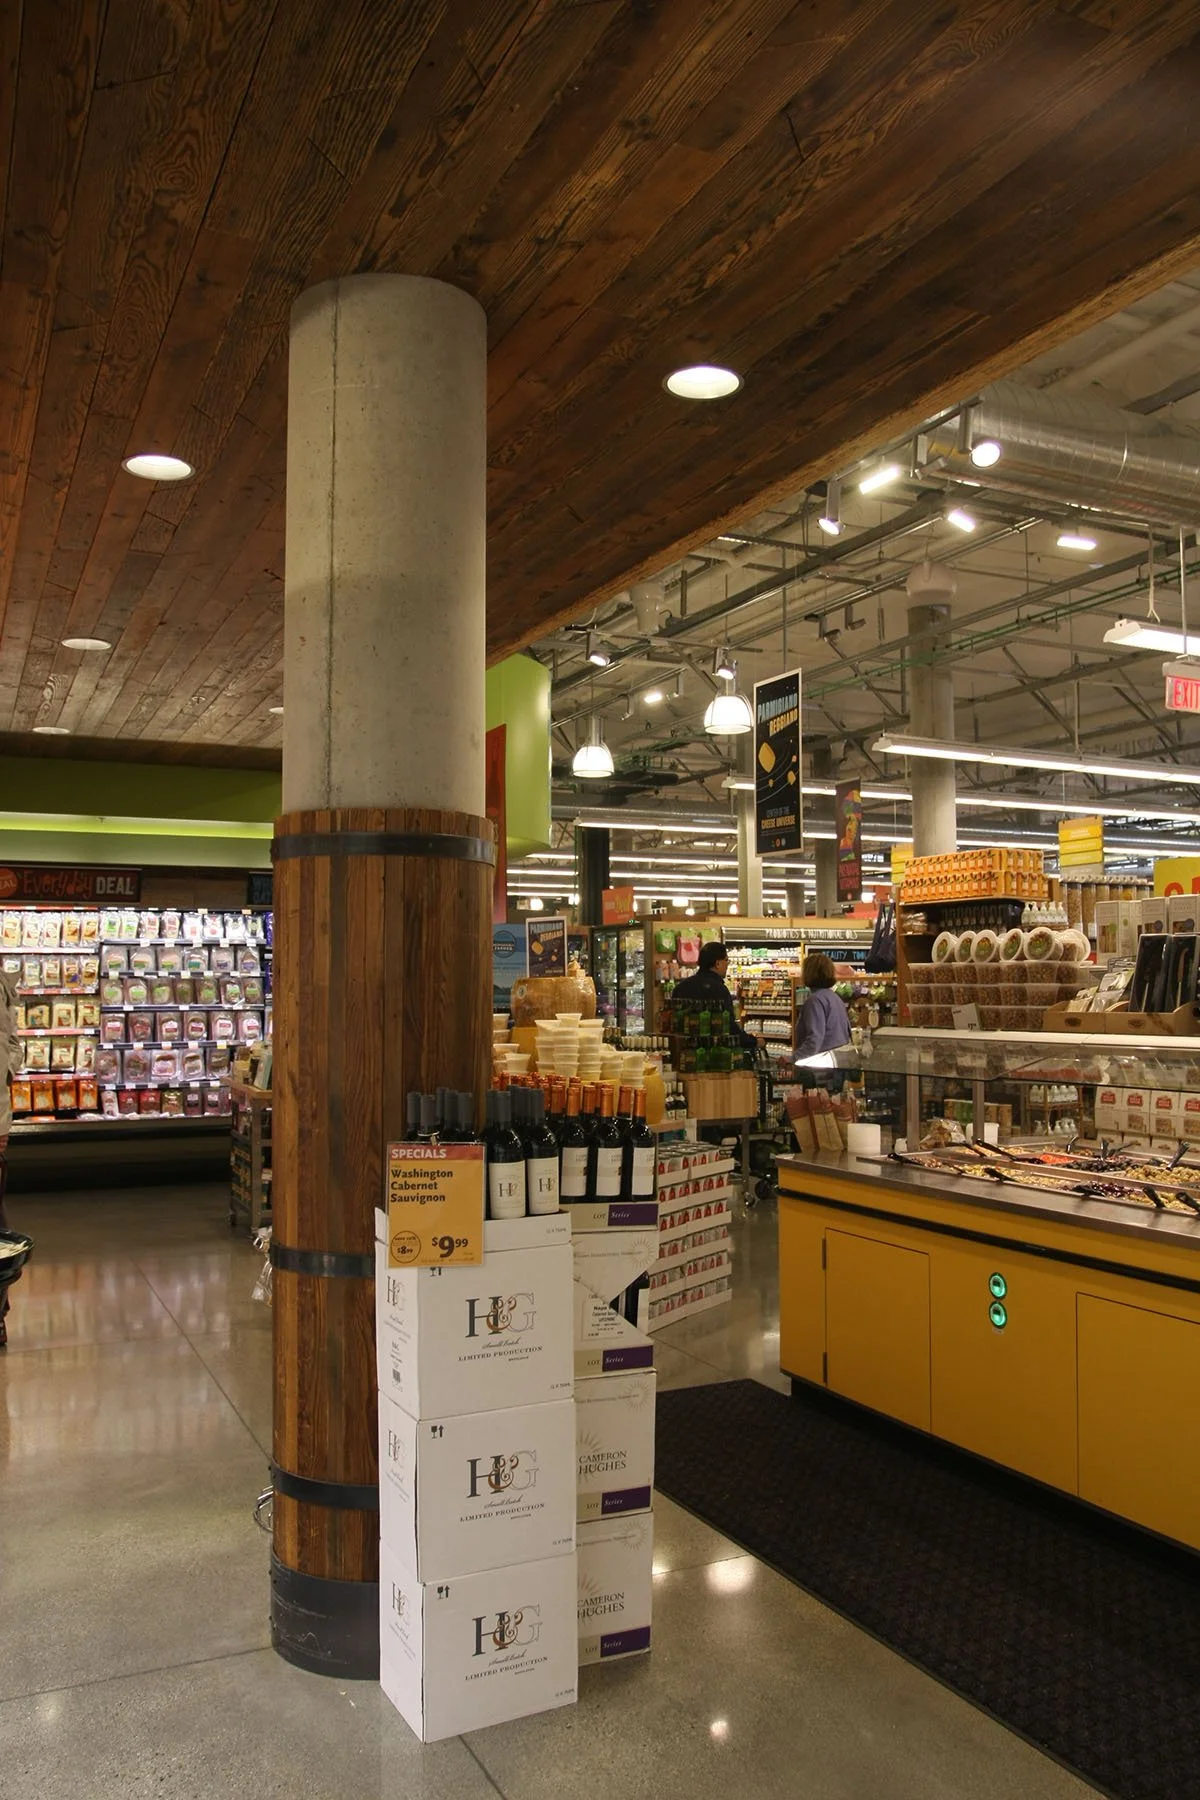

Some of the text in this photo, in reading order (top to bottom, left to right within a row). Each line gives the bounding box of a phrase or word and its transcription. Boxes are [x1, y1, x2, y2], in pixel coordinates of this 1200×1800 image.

[1173, 678, 1200, 709] EXIT
[95, 877, 135, 895] DEAL
[391, 1148, 447, 1159] SPECIALS
[391, 1168, 453, 1180] Washington
[391, 1181, 438, 1190] Cabernet
[390, 1193, 446, 1204] Sauvignon
[464, 1292, 537, 1338] H&G
[458, 1346, 544, 1362] LIMITED PRODUCTION
[578, 1450, 627, 1464] CAMERON
[466, 1449, 540, 1498] H&G
[578, 1460, 627, 1475] HUGHES
[460, 1503, 545, 1523] LIMITED PRODUCTION
[577, 1592, 625, 1608] CAMERON
[577, 1601, 625, 1619] HUGHES
[472, 1604, 543, 1657] H&G
[465, 1668, 498, 1681] LIMITED
[499, 1656, 548, 1673] PRODUCTION
